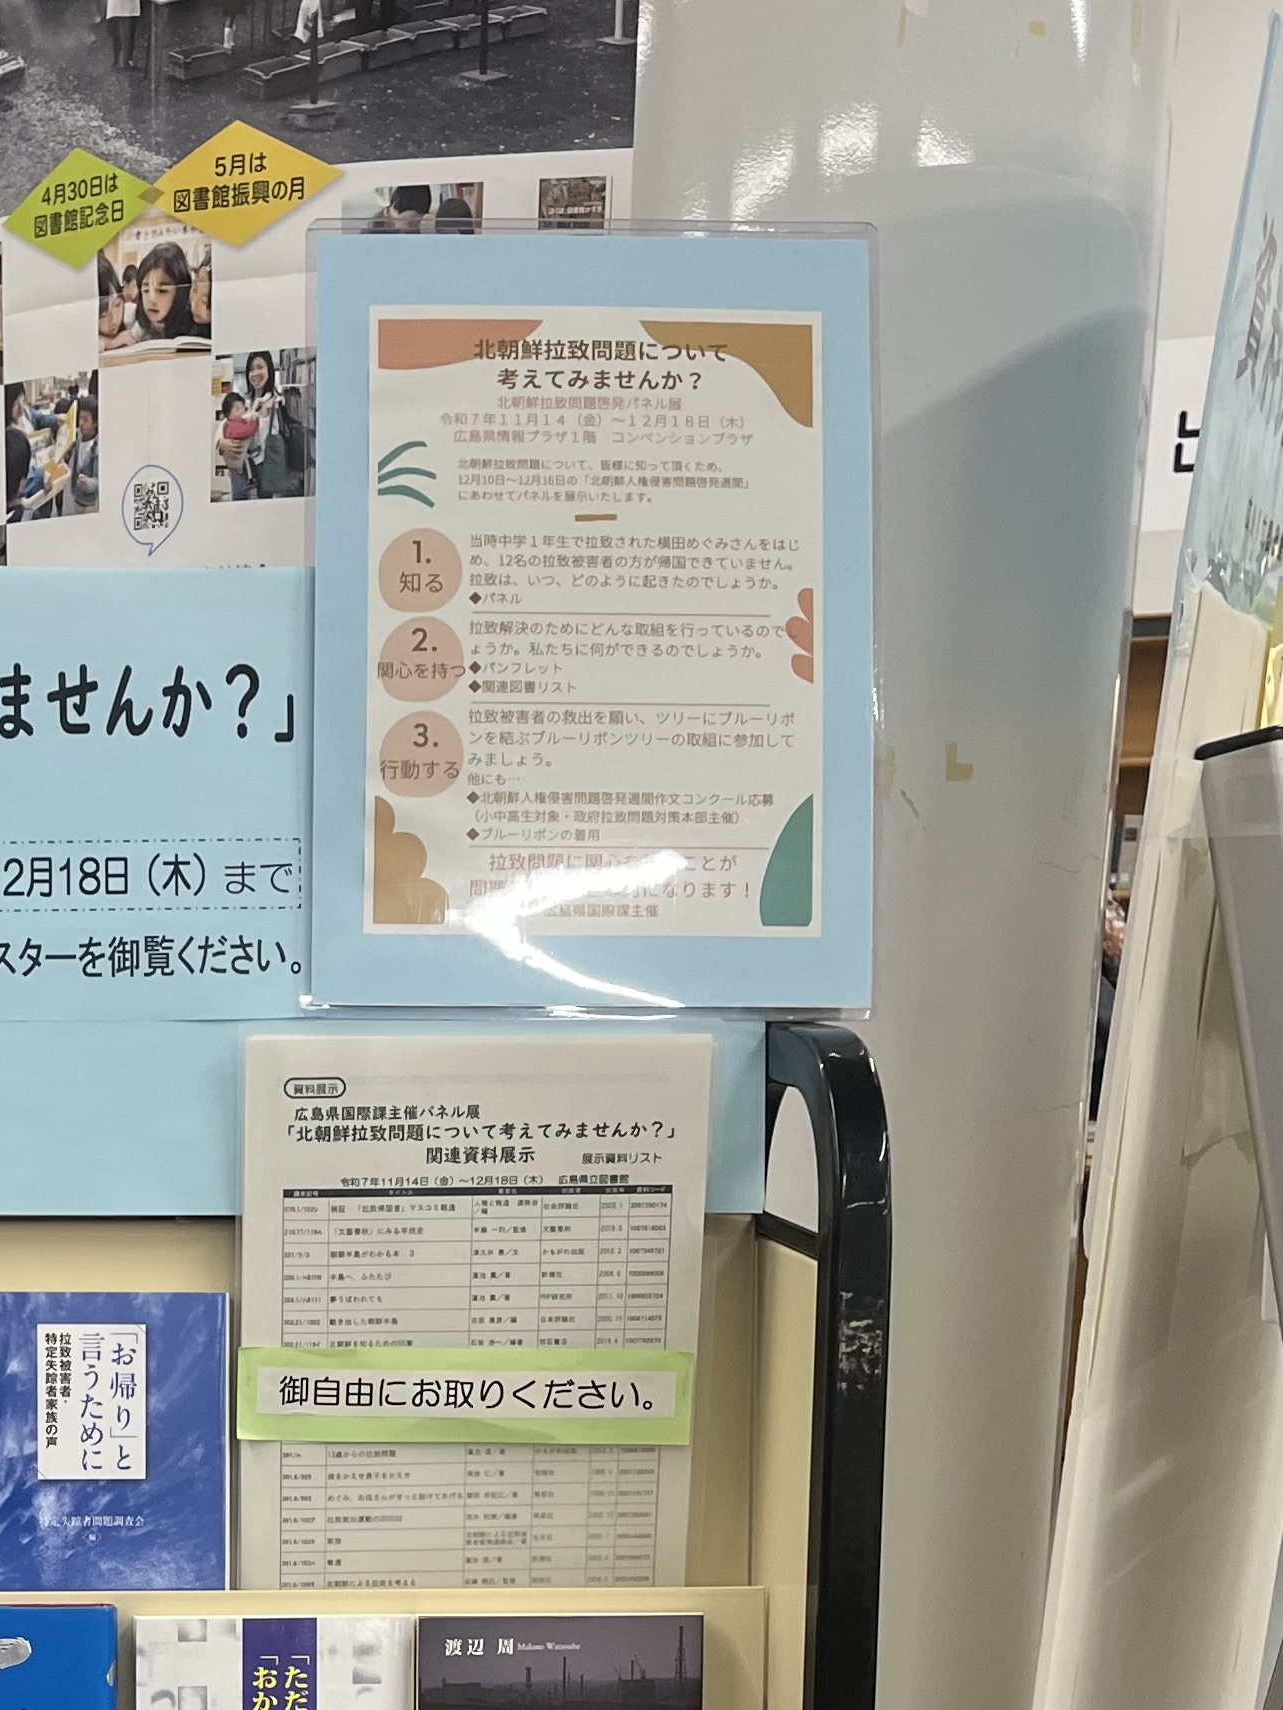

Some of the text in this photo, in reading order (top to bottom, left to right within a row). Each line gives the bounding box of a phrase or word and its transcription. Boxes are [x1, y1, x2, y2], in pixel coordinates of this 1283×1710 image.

[215, 153, 267, 176] 5月は
[41, 172, 118, 206] 4月30日は
[173, 177, 305, 213] 図書館振興の月
[34, 200, 124, 238] 図書館記念日
[474, 340, 727, 362] 北朝鮮拉致問題について
[497, 369, 702, 390] 考えてみませんか？
[497, 396, 681, 411] 北朝鮮拉致問題啓発パネル展
[453, 430, 753, 446] 広島県情報プラザ１階 コンベンションプラザ
[458, 458, 723, 473] 北朝鮮拉致問題について、皆様に知って頂くため、
[458, 490, 652, 504] にあわせてパネルを展示いたします。
[470, 534, 800, 552] 当時中学１年生で拉致された横田めぐみさんをはじ
[412, 541, 431, 564] 1.
[470, 553, 794, 571] め、12名の拉致被害者の方が帰国できていません。
[399, 573, 445, 594] 知る
[470, 573, 779, 590] 拉致は、いつ、どのように起きたのでしょうか。
[411, 628, 438, 652] 2.
[470, 642, 764, 660] ょうか。私たちに何ができるのでしょうか。
[377, 662, 466, 680] 関心を持つ
[481, 680, 576, 695] 関連図書リスト
[468, 709, 795, 727] 拉致被害者の救出を願い、ツリーにブルーリボ
[413, 723, 439, 748] 3.
[469, 731, 794, 749] ンを結ぶブルーリボンツリーの取組に参加して
[468, 752, 554, 768] みましょう。
[380, 760, 460, 781] 行動する
[480, 828, 600, 842] ブルーリボンの着用
[293, 1083, 339, 1095] 資料展示
[294, 1104, 481, 1122] 広島県国際課主催パネル展
[286, 1120, 675, 1145] 「北朝鮮拉致問題について考えてみませんか？」
[425, 1147, 536, 1165] 関連資料展示
[581, 1152, 663, 1165] 展示資料リスト
[558, 1173, 630, 1185] 広島県立図書館
[45, 1333, 58, 1448] 特定失踪者家族の声
[279, 1376, 654, 1410] 御自由にお取りください。
[78, 1333, 105, 1471] 言うために
[110, 1332, 138, 1470] 「お帰り」と
[444, 1638, 484, 1656] 渡辺
[497, 1638, 514, 1656] 周
